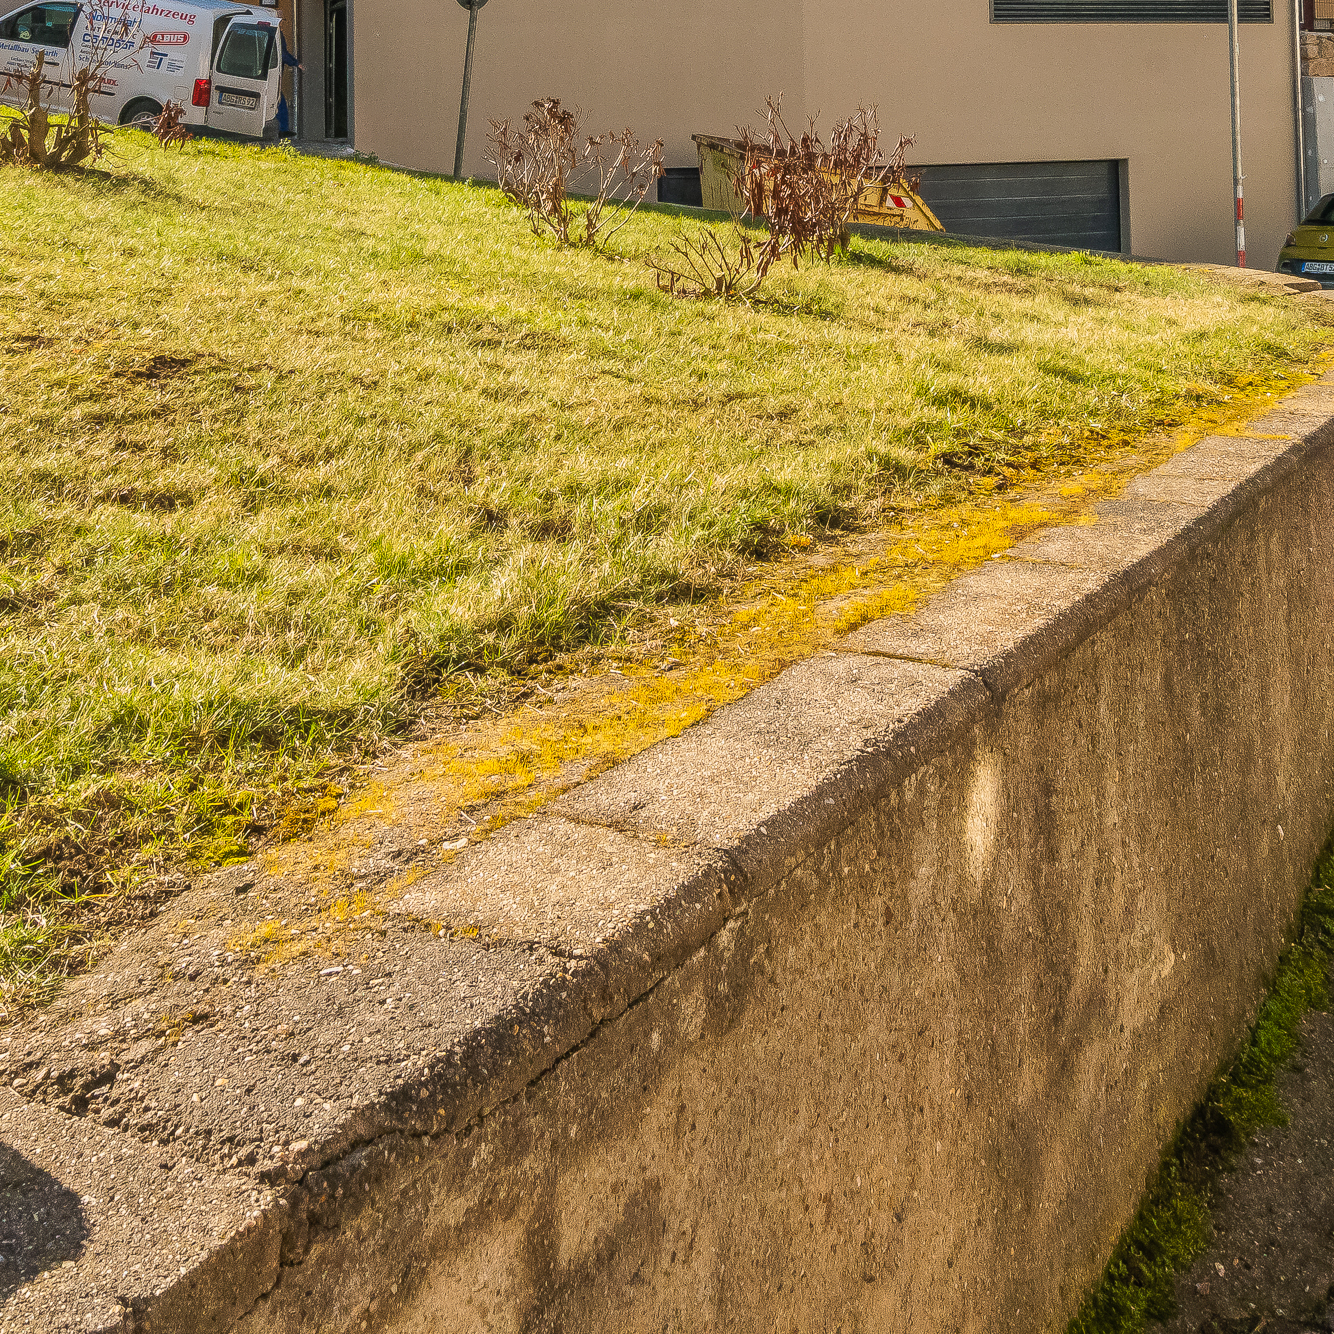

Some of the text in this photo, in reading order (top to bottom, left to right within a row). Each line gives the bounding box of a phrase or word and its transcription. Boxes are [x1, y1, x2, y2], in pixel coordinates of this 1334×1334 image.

[155, 33, 185, 43] ABUS
[222, 93, 235, 103] ABG
[238, 96, 247, 105] RS
[1305, 263, 1318, 271] ABG
